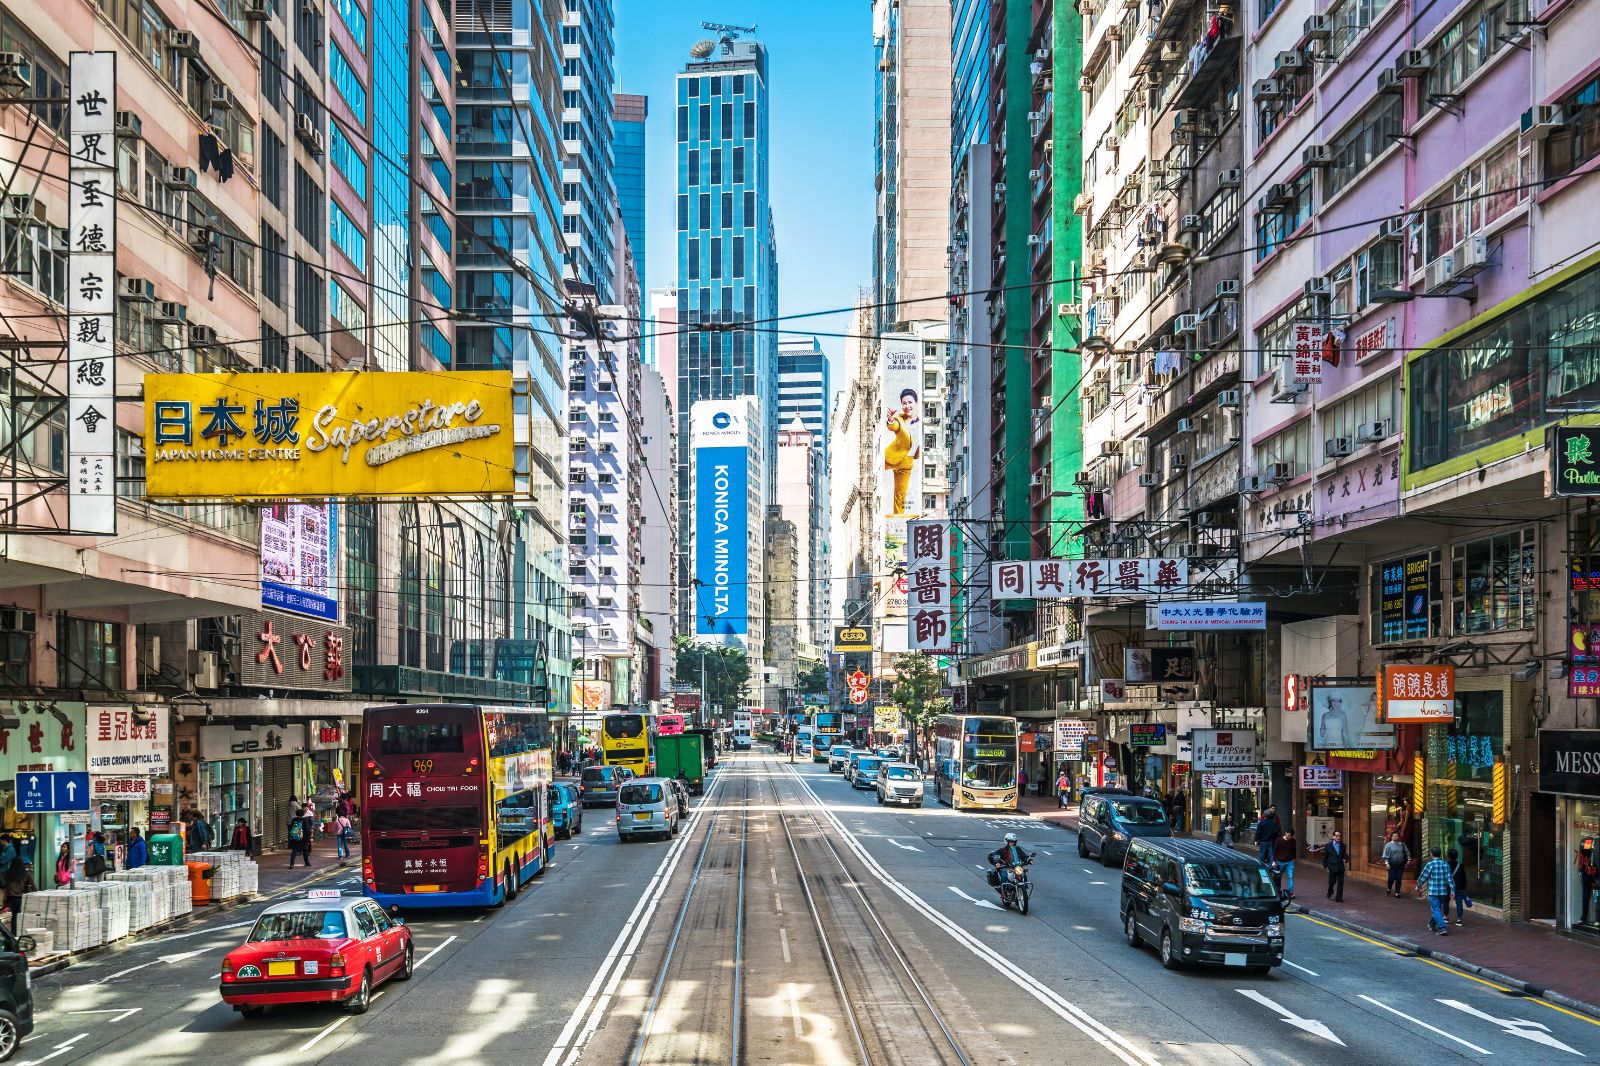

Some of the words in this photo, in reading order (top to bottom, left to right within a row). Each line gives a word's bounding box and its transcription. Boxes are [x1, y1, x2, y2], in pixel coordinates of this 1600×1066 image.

[153, 397, 300, 446] 日本城
[305, 399, 484, 464] Superstore
[154, 449, 198, 464] JAPAN
[200, 448, 246, 462] HOME
[248, 448, 300, 461] CENTRE
[714, 464, 729, 534] KONICA
[1407, 560, 1428, 575] BRIGHT
[714, 540, 729, 616] MINOLTA
[91, 757, 110, 766] SILVER
[112, 755, 130, 765] CROWN
[132, 754, 152, 764] OPTICAL
[413, 759, 433, 773] 969
[27, 790, 42, 798] Bus
[95, 780, 146, 793] 皇冠眼鏡
[369, 782, 422, 798] 周大福
[25, 800, 44, 808] 巴士
